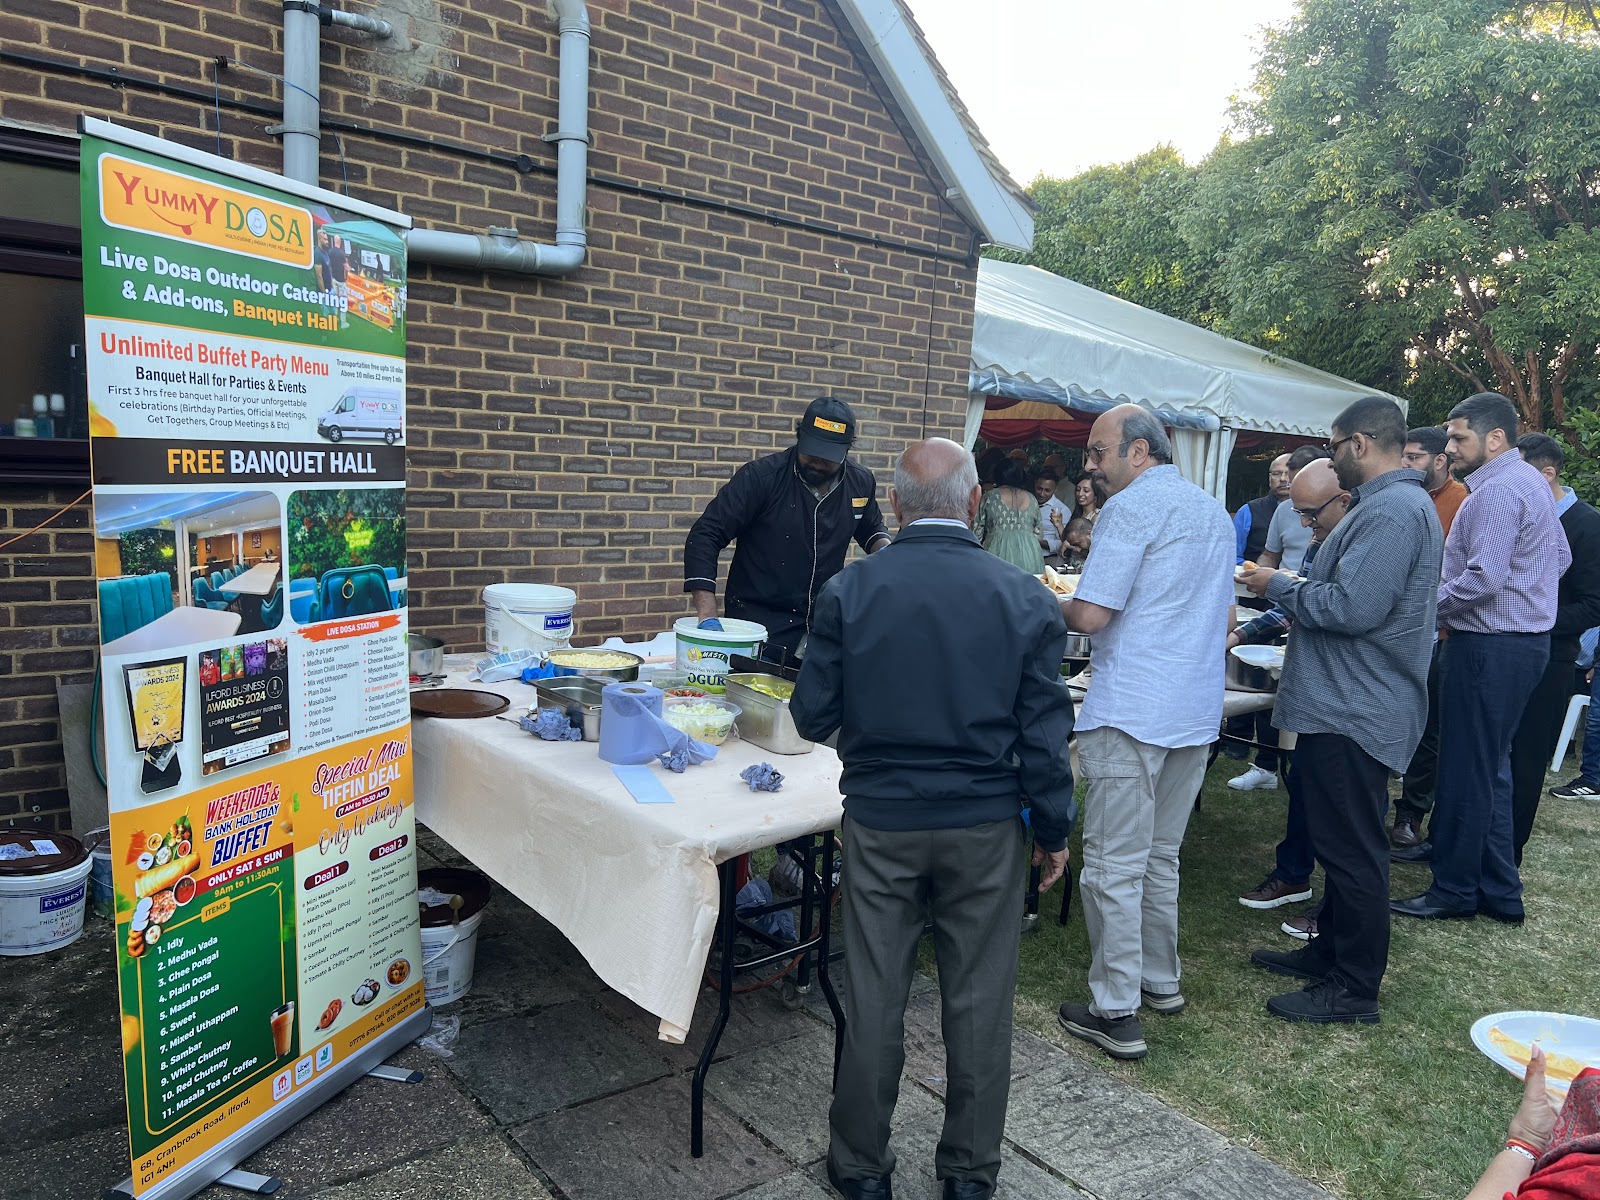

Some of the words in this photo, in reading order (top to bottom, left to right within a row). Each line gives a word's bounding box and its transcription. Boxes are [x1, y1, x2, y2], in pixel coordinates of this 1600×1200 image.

[224, 200, 305, 248] DOSA
[100, 246, 149, 272] Live
[153, 255, 202, 282] Dosa
[206, 267, 279, 297] Outdoor
[282, 282, 349, 313] Catering
[122, 280, 138, 301] &
[143, 283, 229, 317] Add-ons,
[233, 299, 303, 327] Banquet
[307, 312, 339, 332] Hall
[100, 332, 194, 362] Unlimited
[197, 343, 248, 368] Buffet
[251, 350, 288, 376] Party
[291, 355, 329, 377] Menu
[135, 365, 187, 385] Banquet
[189, 371, 210, 386] Hall
[212, 373, 227, 388] for
[229, 375, 266, 391] Parties
[268, 378, 276, 392] &
[277, 379, 307, 394] Events
[340, 369, 355, 378] Above
[356, 371, 362, 379] 10
[108, 385, 132, 396] First
[134, 387, 141, 396] 3
[142, 387, 158, 398] hrs
[160, 388, 178, 399] free
[179, 390, 213, 402] banquet
[213, 393, 228, 402] hall
[229, 394, 241, 403] for
[241, 395, 260, 406] your
[261, 397, 308, 408] unforgettable
[119, 400, 179, 412] celebrations
[180, 403, 216, 416] (Birthday
[217, 406, 246, 417] Parties,
[247, 407, 274, 418] Official
[274, 410, 308, 421] Meetings,
[147, 414, 164, 424] Get
[165, 415, 208, 427] Togethers,
[209, 417, 233, 428] Group
[234, 418, 270, 431] Meetings
[270, 421, 276, 430] &
[276, 420, 290, 431] Etc)
[167, 448, 226, 475] FREE
[230, 449, 326, 477] BANQUET
[329, 451, 377, 475] HALL
[326, 625, 339, 636] LIVE
[339, 623, 356, 635] DOSA
[356, 620, 380, 632] STATION
[702, 650, 726, 660] MASTI
[205, 687, 232, 702] ILFORD
[232, 679, 266, 696] BUSINESS
[688, 672, 726, 686] OGUR
[205, 695, 245, 715] AWARDS
[245, 690, 267, 705] 2024
[312, 747, 375, 797] Special
[374, 737, 408, 771] Mini
[321, 775, 365, 810] TIFFIN
[368, 761, 401, 790] DEAL
[205, 780, 273, 826] WEEKENDS
[270, 784, 281, 802] &
[204, 819, 233, 841] BANK
[235, 802, 281, 830] HOLIDAY
[210, 820, 274, 868] BUFFET
[378, 841, 397, 857] Deal
[397, 839, 403, 849] 2
[207, 868, 234, 887] ONLY
[235, 860, 254, 876] SAT
[255, 857, 262, 868] &
[263, 849, 283, 865] SUN
[214, 884, 235, 898] 9Am
[235, 879, 244, 889] to
[245, 865, 280, 884] 11:30Am
[314, 867, 335, 885] Deal
[335, 865, 340, 876] 1
[43, 887, 84, 908] EVEREST
[205, 900, 227, 917] ITEMS
[157, 945, 166, 955] 1.
[167, 936, 185, 951] Idly
[157, 961, 167, 972] 2.
[167, 947, 197, 967] Medhu
[197, 936, 219, 951] Vada
[157, 977, 167, 988] 3.
[168, 966, 191, 983] Ghee
[191, 949, 220, 971] Pongal
[158, 993, 168, 1004] 4.
[168, 981, 191, 999] Plain
[191, 971, 212, 987] Dosa
[159, 1010, 168, 1021] 5.
[169, 993, 199, 1016] Masala
[199, 983, 220, 1000] Dosa
[160, 1026, 169, 1037] 6.
[169, 1011, 197, 1032] Sweet
[160, 1044, 168, 1055] 7.
[169, 1027, 195, 1050] Mixed
[195, 1005, 240, 1034] Uthappam
[374, 1010, 385, 1021] Call
[160, 1061, 169, 1072] 8.
[170, 1040, 203, 1066] Sambar
[160, 1077, 170, 1087] 9.
[170, 1059, 197, 1081] White
[197, 1039, 232, 1064] Chutney
[161, 1092, 175, 1103] 10.
[175, 1079, 193, 1095] Red
[194, 1057, 229, 1083] Chutney
[161, 1107, 175, 1120] 11.
[176, 1088, 205, 1112] Masala
[205, 1078, 221, 1092] Tea
[222, 1072, 232, 1083] or
[232, 1056, 258, 1077] Coffee
[156, 1128, 202, 1162] Cranbrook
[203, 1112, 226, 1132] Road,
[228, 1096, 251, 1116] Ilford,
[141, 1170, 155, 1186] IG1
[156, 1156, 177, 1175] 4NH
